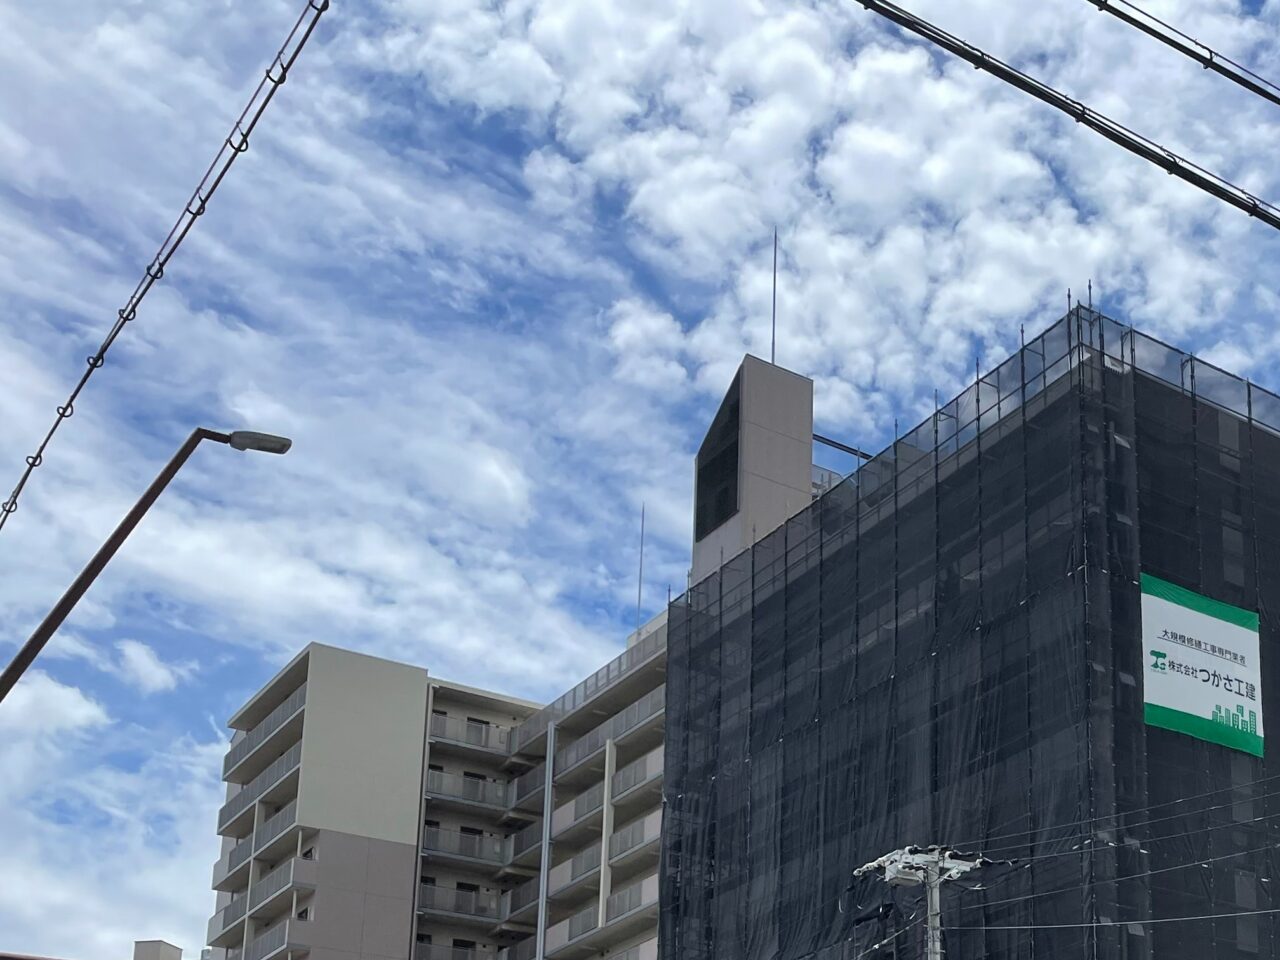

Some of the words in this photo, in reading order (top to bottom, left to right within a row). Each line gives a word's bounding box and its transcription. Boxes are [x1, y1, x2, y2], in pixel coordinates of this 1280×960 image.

[1168, 660, 1256, 701] 株式会社つかさ工建
